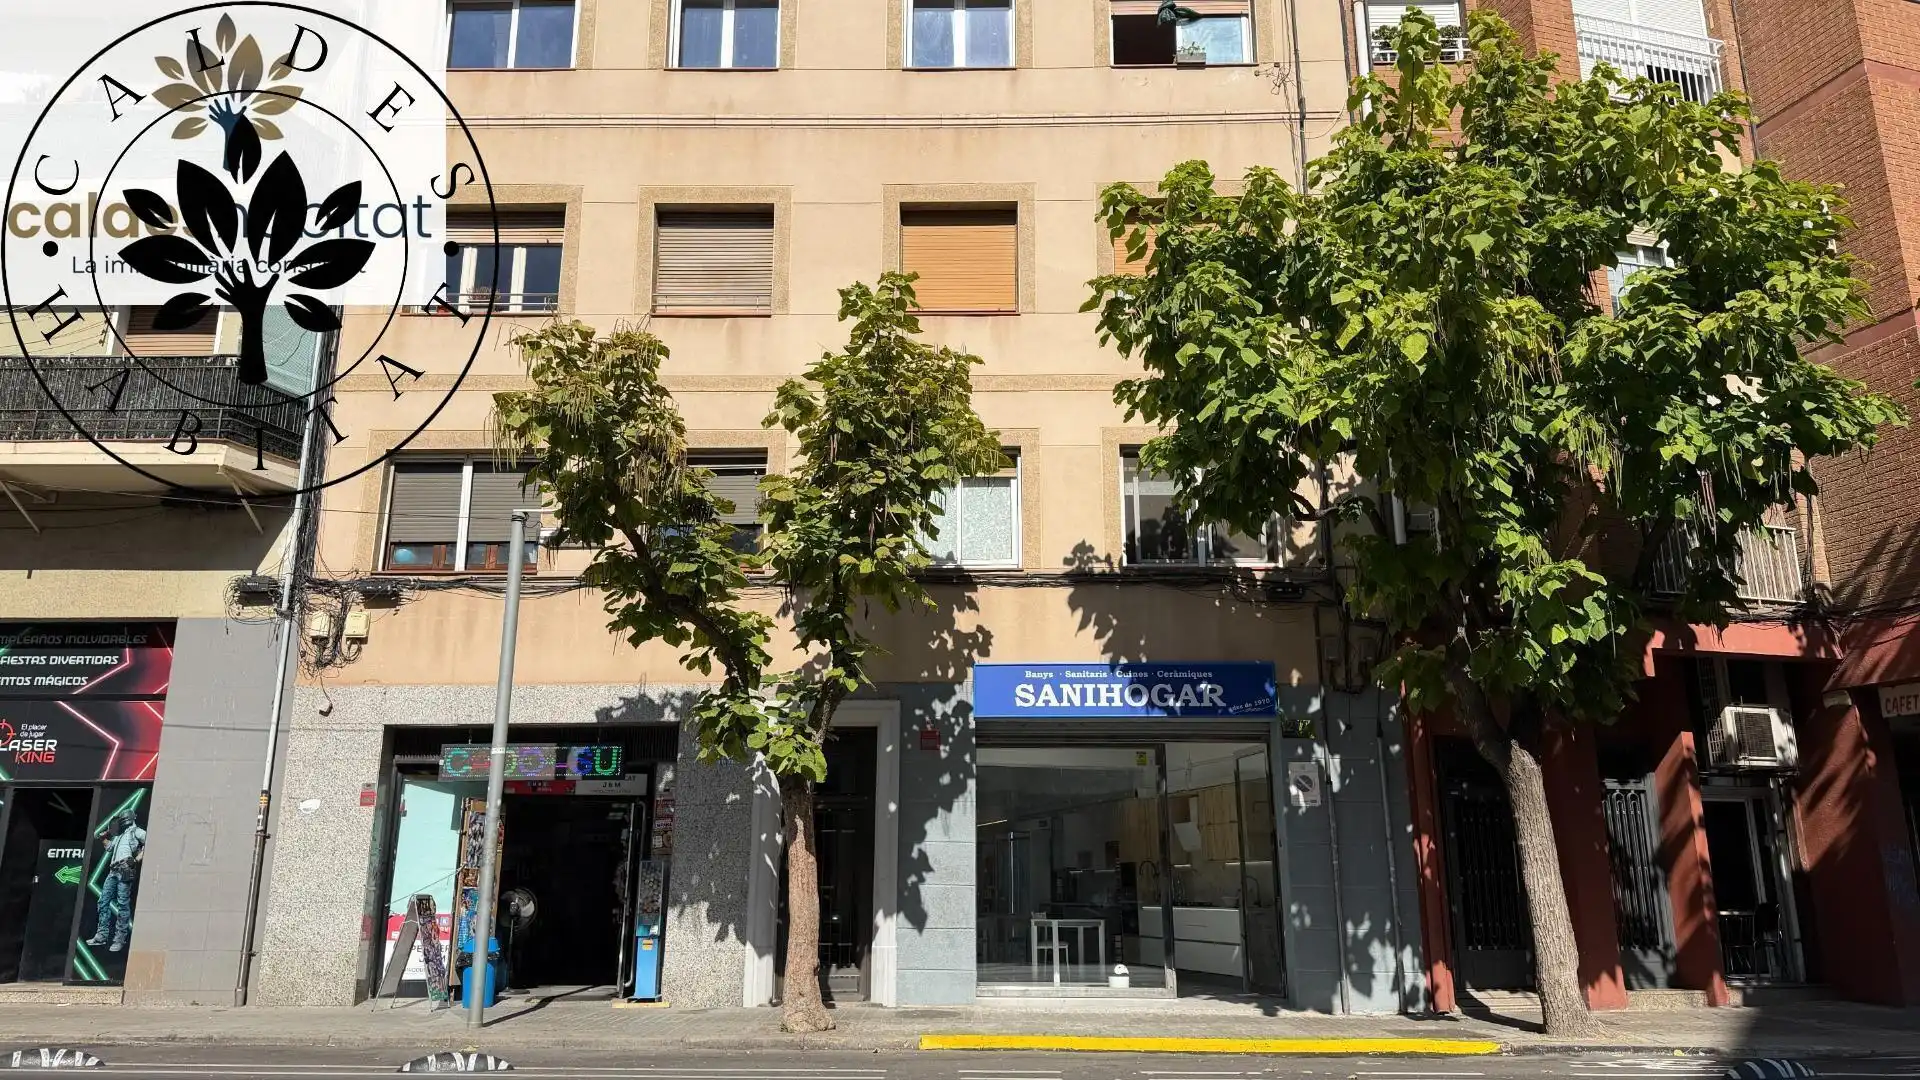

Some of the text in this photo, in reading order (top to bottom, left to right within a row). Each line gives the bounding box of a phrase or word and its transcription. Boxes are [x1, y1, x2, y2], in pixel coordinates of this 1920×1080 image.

[65, 634, 148, 645] INOLVIDABLES
[0, 655, 119, 665] FIESTAS DIVERTIDAS
[0, 674, 88, 686] NTOS MÁGICOS
[1025, 670, 1213, 680] Banys Sanitaris Cuines Ceràmiques
[1014, 683, 1227, 707] SANIHOGAR
[21, 723, 48, 732] El placer
[29, 731, 46, 739] jugar
[0, 739, 58, 752] LASER
[15, 751, 56, 763] KING
